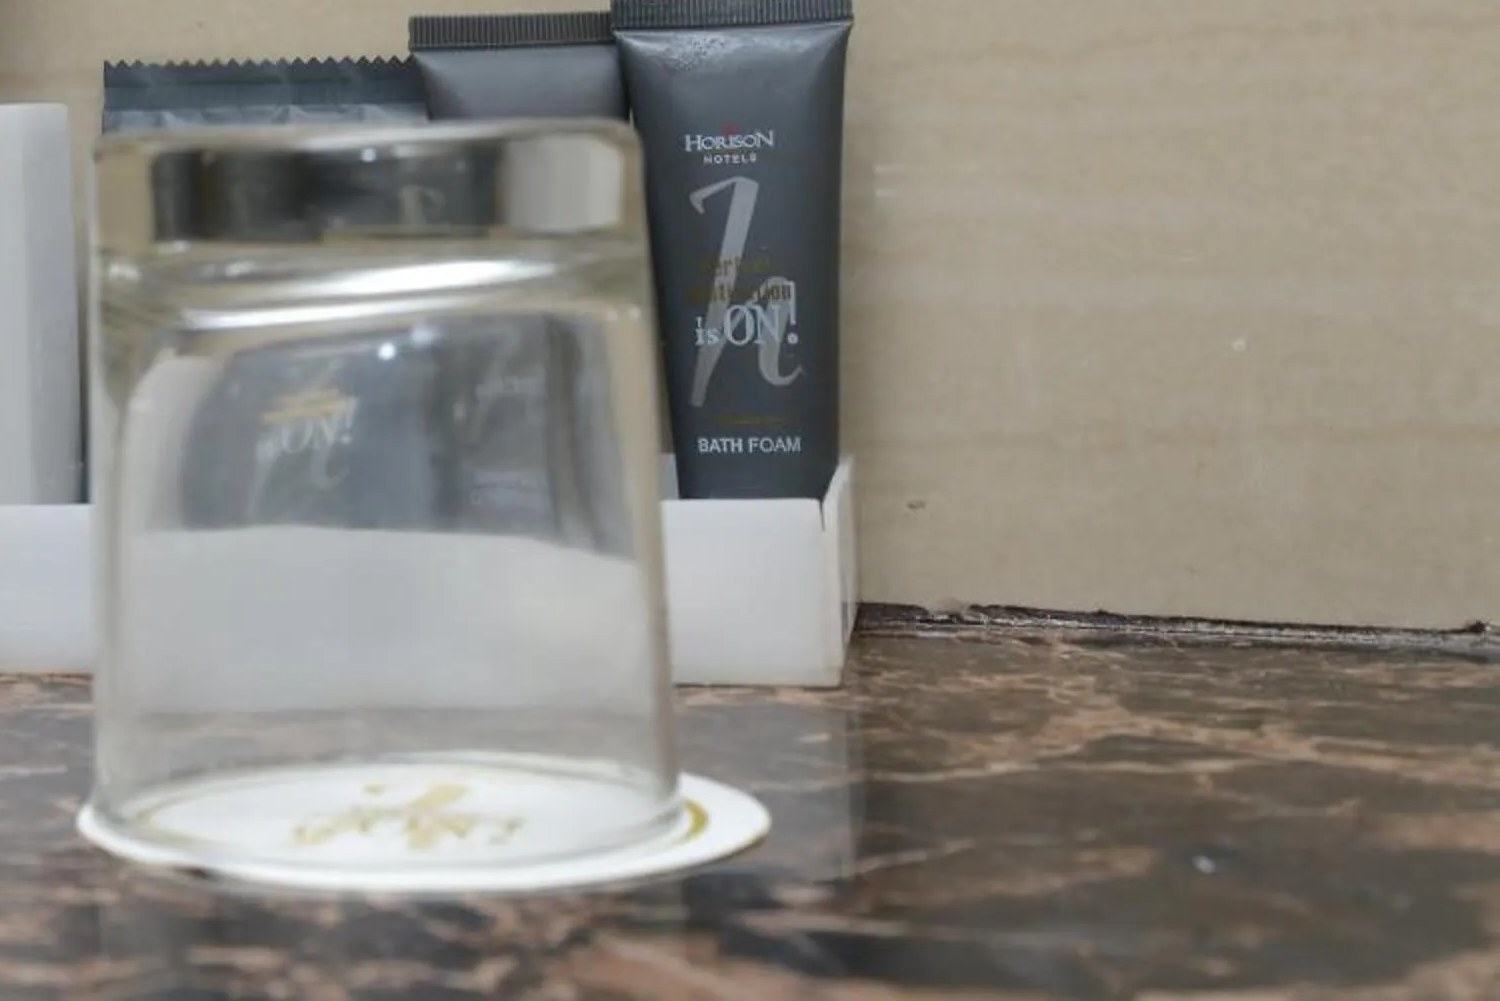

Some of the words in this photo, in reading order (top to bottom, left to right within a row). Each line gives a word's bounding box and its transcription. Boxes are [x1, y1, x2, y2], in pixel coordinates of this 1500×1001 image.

[703, 153, 758, 165] HOTELS
[698, 437, 743, 454] BATH
[748, 436, 802, 453] FOAM
